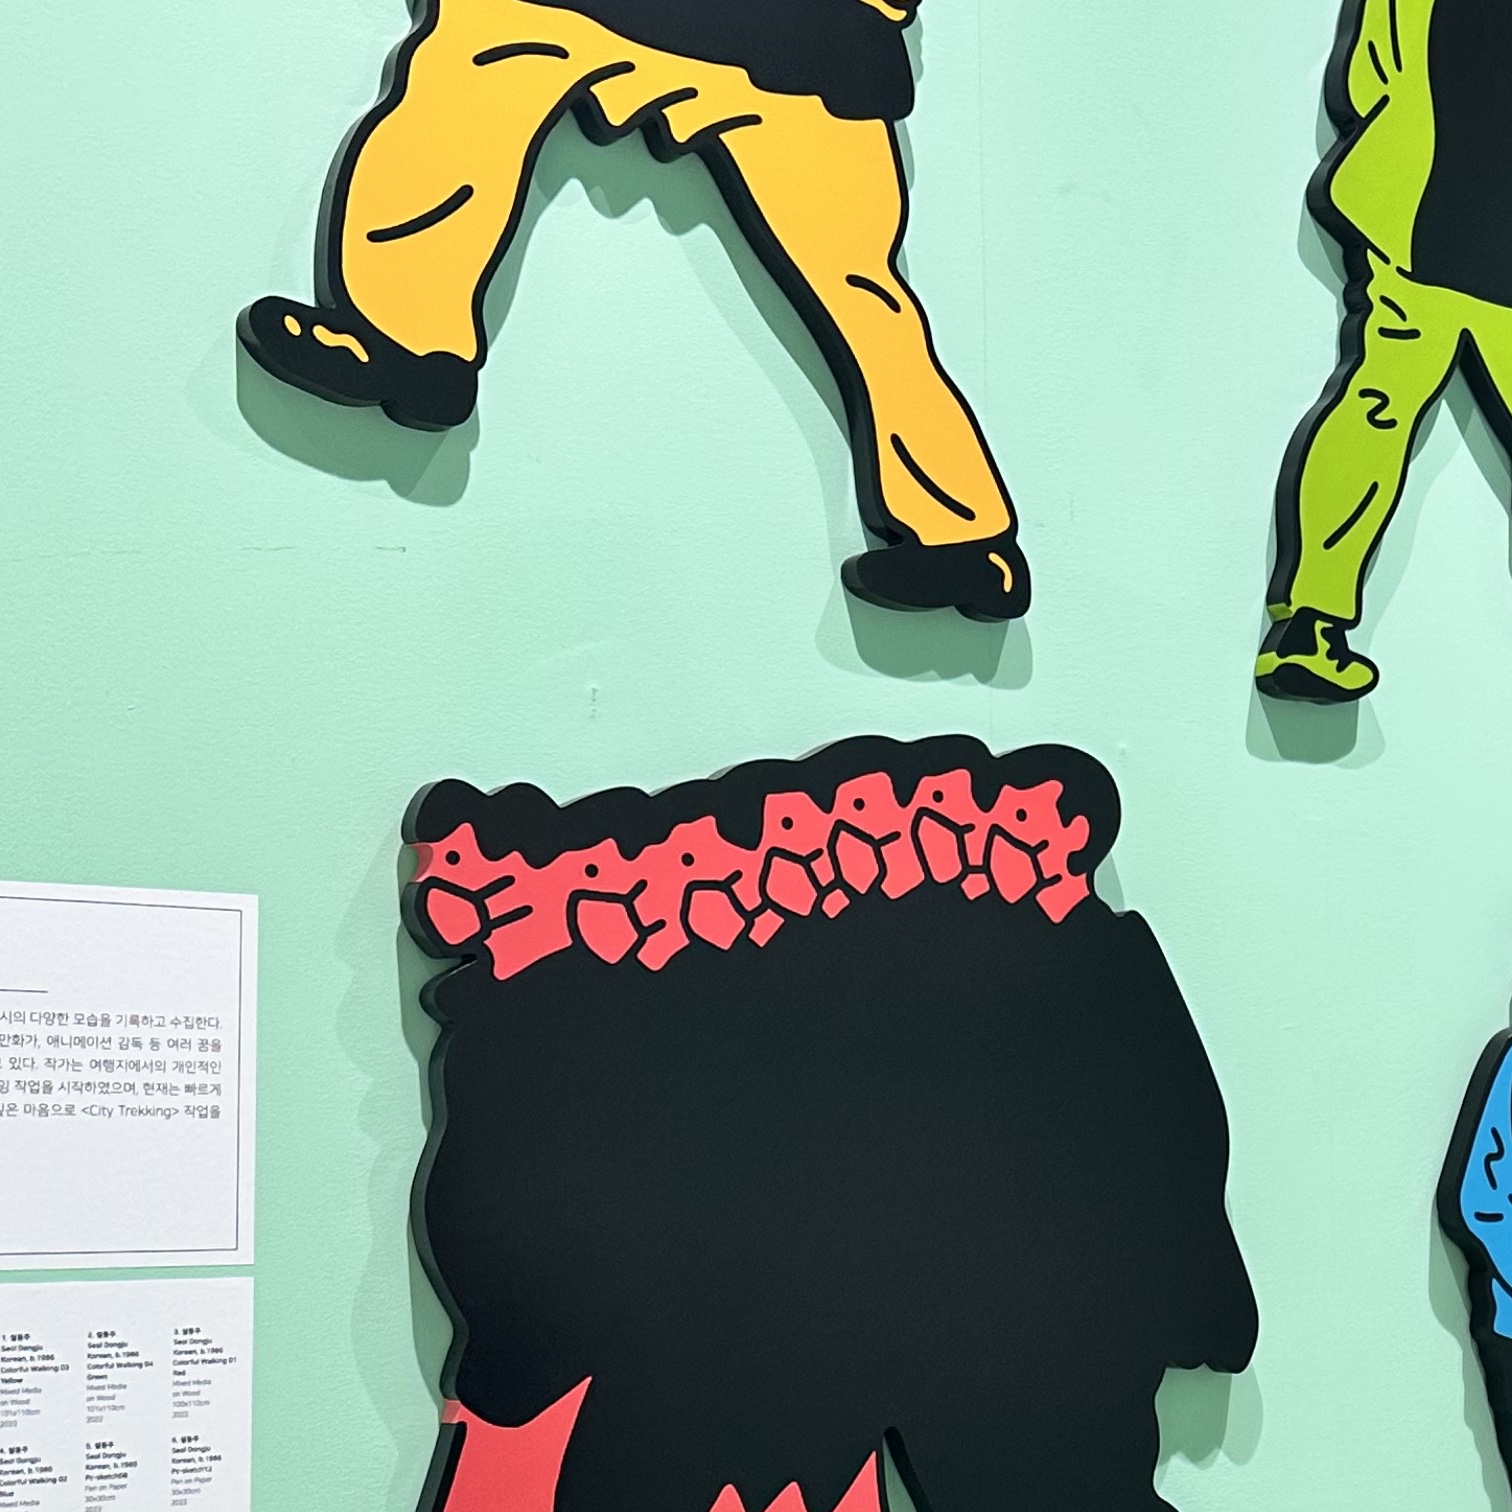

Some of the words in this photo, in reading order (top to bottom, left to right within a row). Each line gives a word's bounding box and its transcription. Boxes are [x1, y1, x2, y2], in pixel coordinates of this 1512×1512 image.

[30, 1011, 69, 1027] 다양한
[72, 1012, 112, 1028] 모습을
[115, 1013, 166, 1029] 기록하고
[169, 1015, 223, 1030] 수집한다.
[46, 1035, 112, 1050] 애니메이션
[118, 1036, 144, 1051] 감독
[149, 1037, 161, 1052] 등
[167, 1037, 192, 1052] 여러
[197, 1038, 222, 1053] 꿈을
[9, 1056, 39, 1071] 있다.
[44, 1057, 83, 1073] 작가는
[89, 1058, 167, 1074] 여행지에서의
[172, 1060, 222, 1075] 개인적인
[14, 1080, 54, 1095] 작업을
[143, 1082, 181, 1097] 현재는
[184, 1082, 222, 1097] 빠르게
[23, 1103, 77, 1118] 마음으로
[81, 1104, 115, 1120] <City
[118, 1104, 180, 1121] Trekking>
[184, 1104, 221, 1120] 작업을
